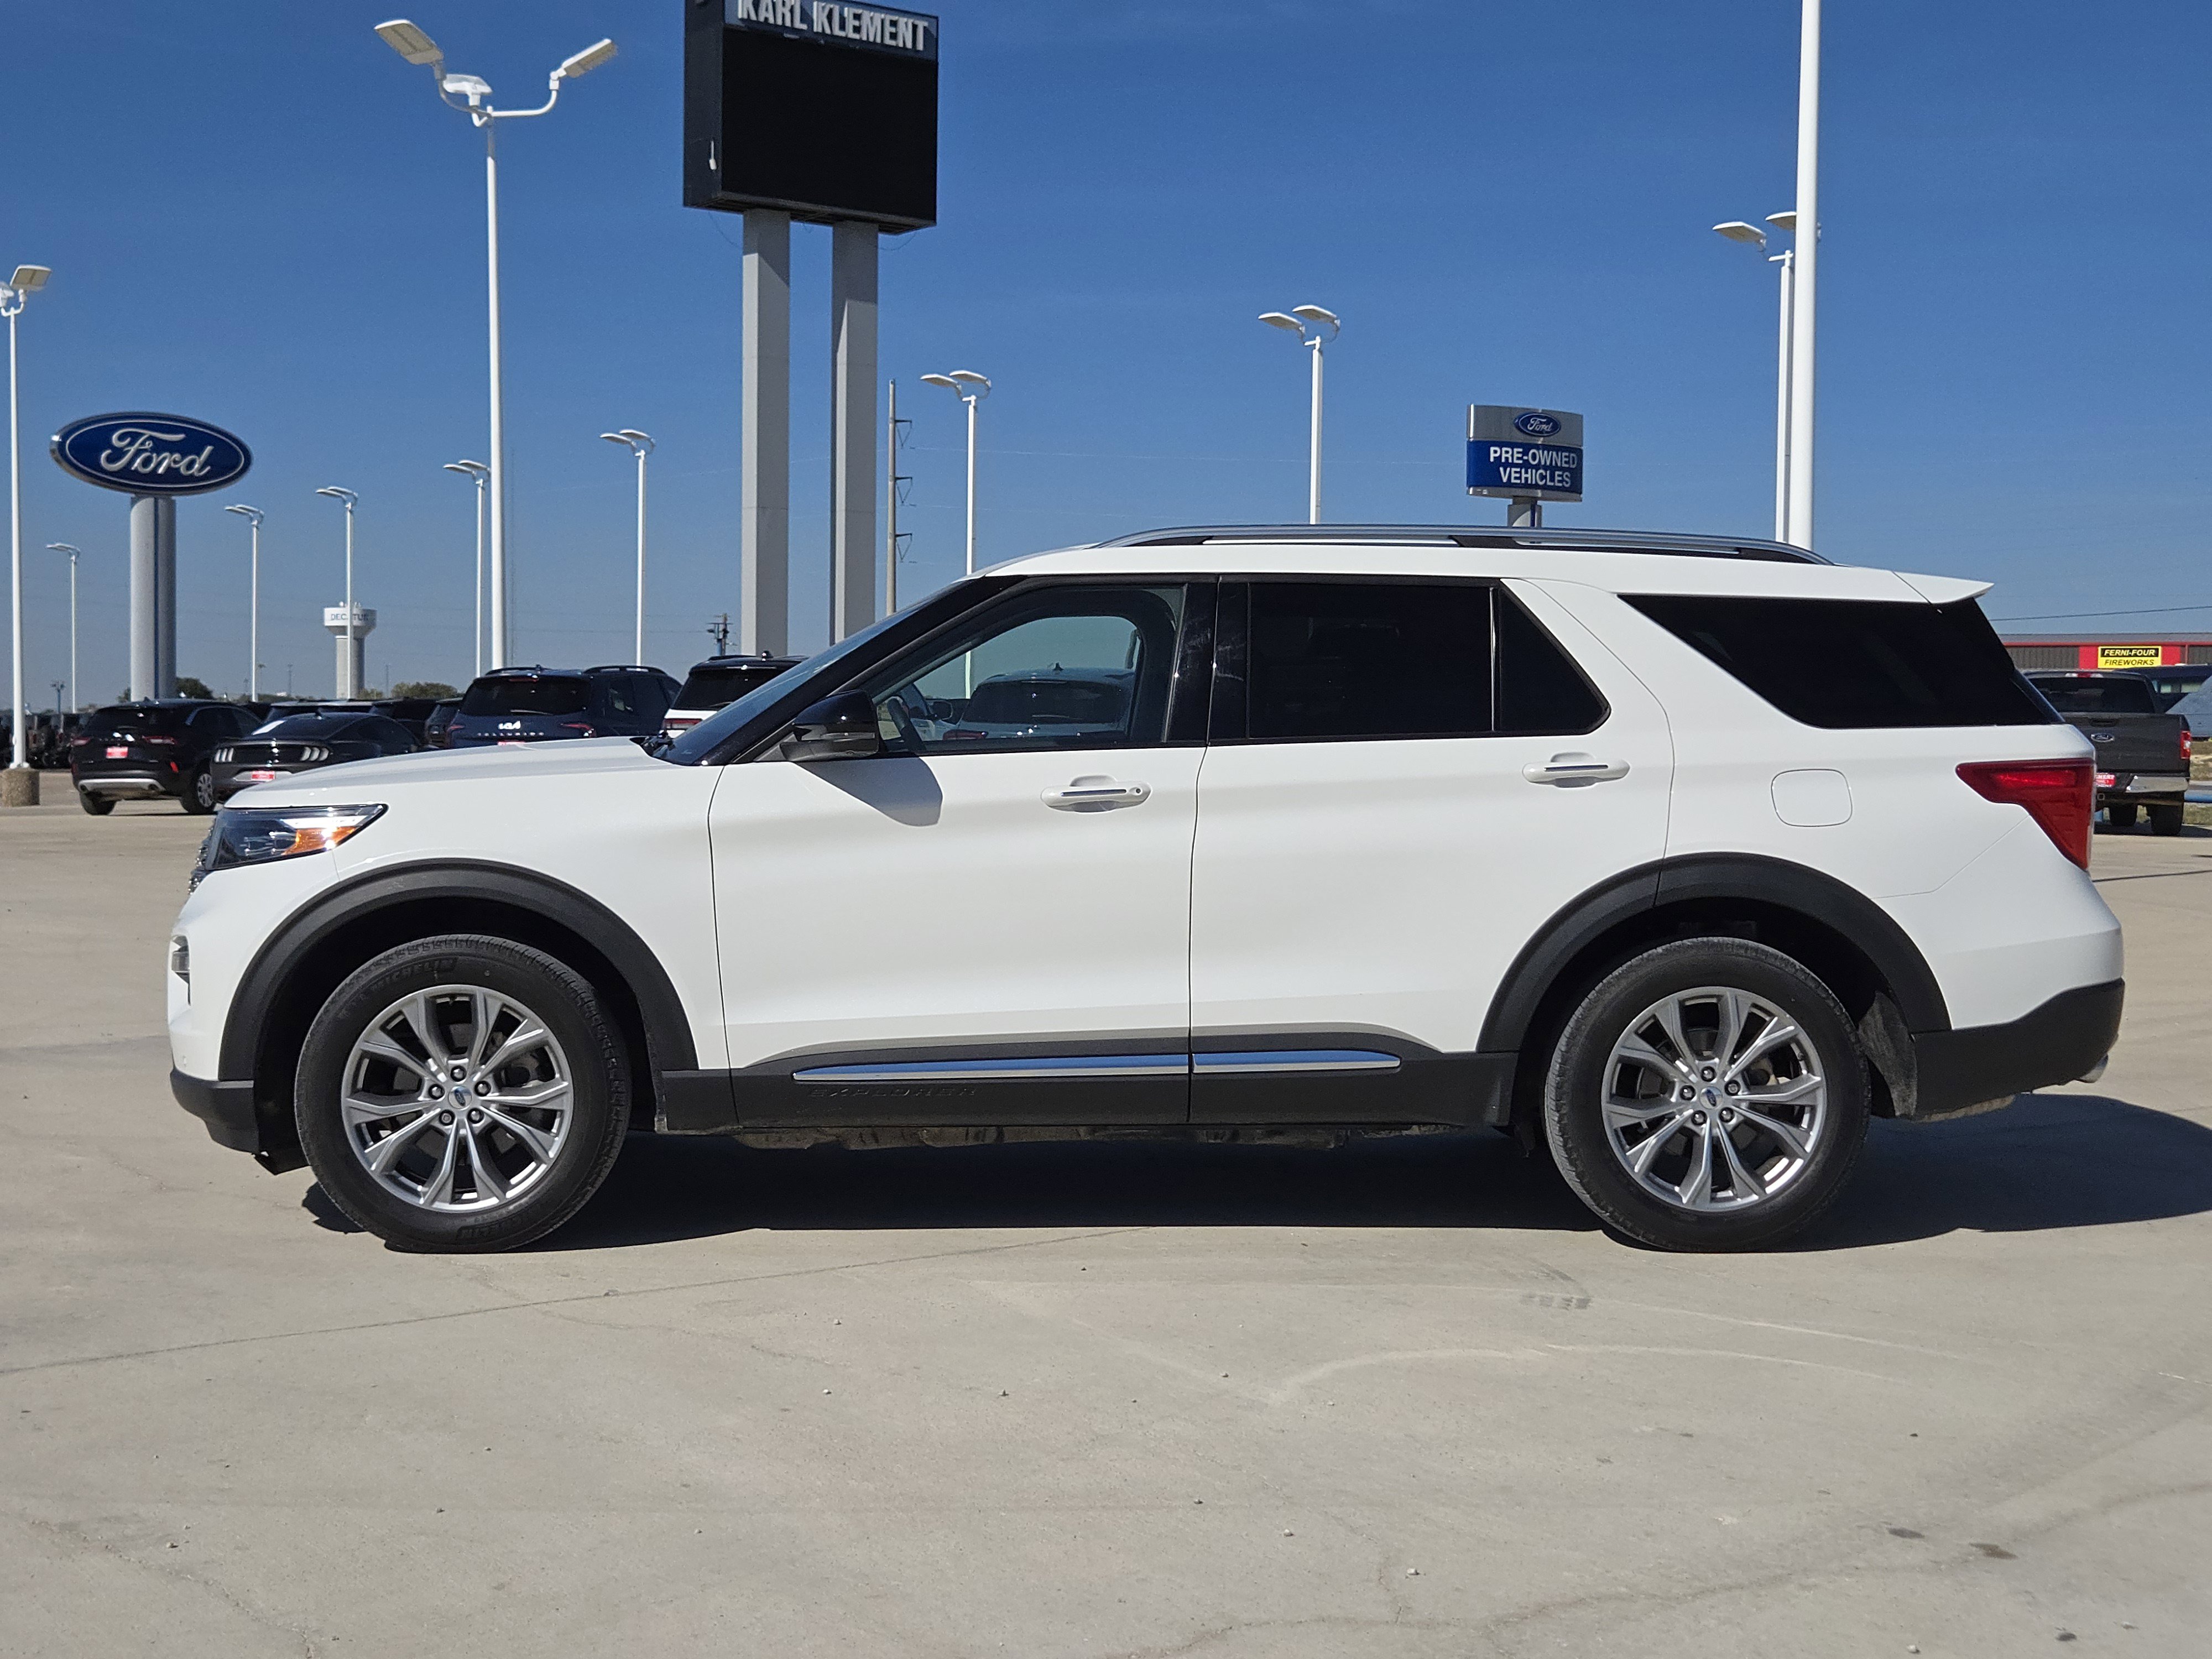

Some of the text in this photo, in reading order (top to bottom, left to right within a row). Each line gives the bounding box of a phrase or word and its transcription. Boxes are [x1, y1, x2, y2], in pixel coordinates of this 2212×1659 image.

[738, 0, 928, 51] KARL KLEMENT
[1527, 418, 1552, 431] Ford
[101, 428, 214, 477] Ford
[1490, 447, 1576, 468] PRE-OWNED
[1500, 467, 1571, 487] VEHICLES
